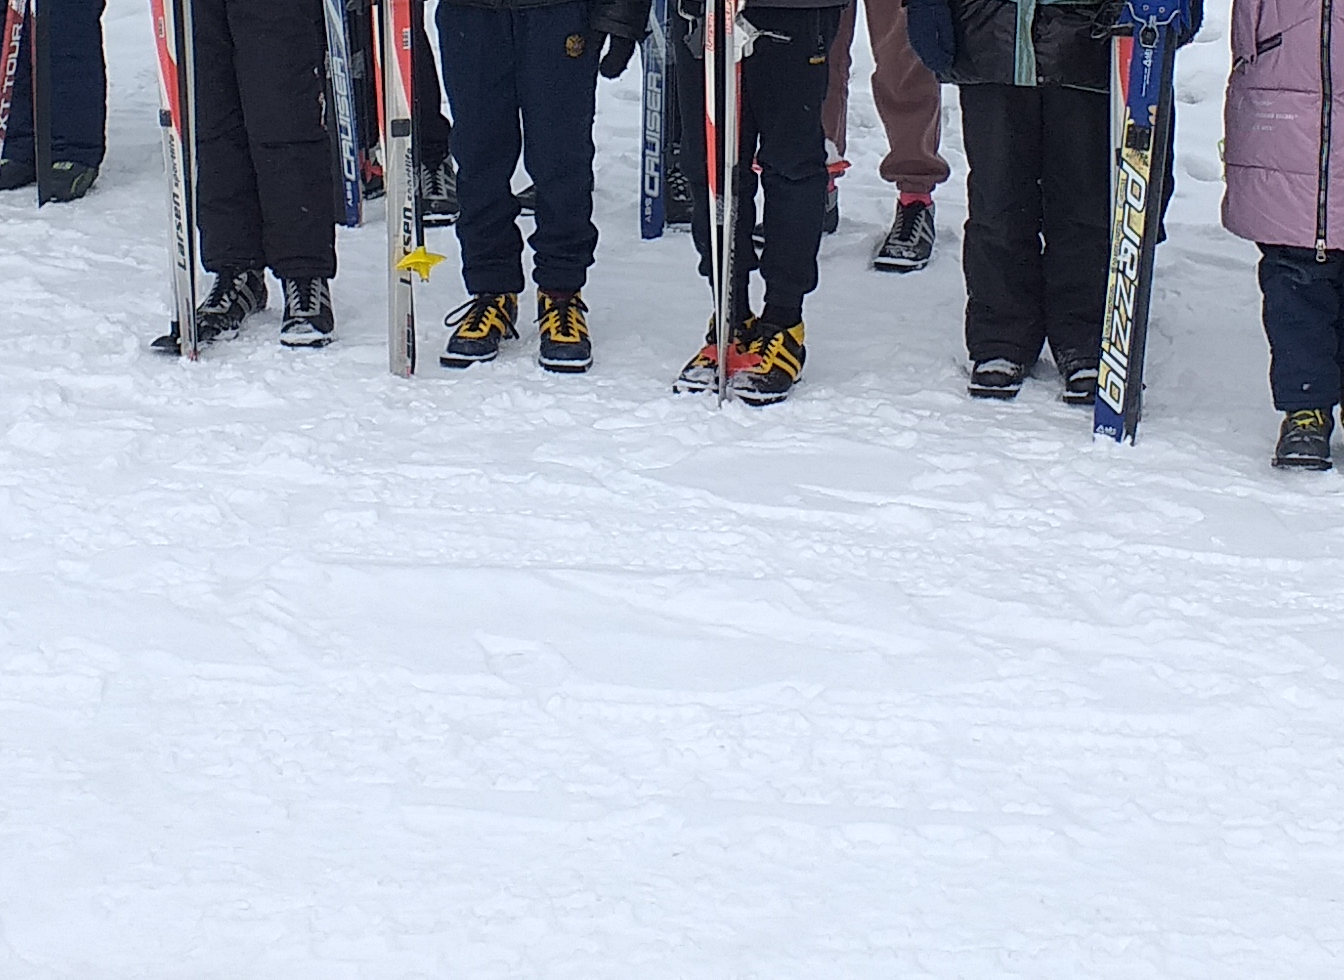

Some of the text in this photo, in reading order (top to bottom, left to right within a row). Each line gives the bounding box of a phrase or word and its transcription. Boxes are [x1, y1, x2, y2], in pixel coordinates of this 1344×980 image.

[1, 22, 24, 93] TOUR
[332, 56, 357, 182] CRUISER
[645, 71, 663, 197] CRUISER
[172, 191, 188, 272] Larsen
[1098, 158, 1149, 415] blizzard
